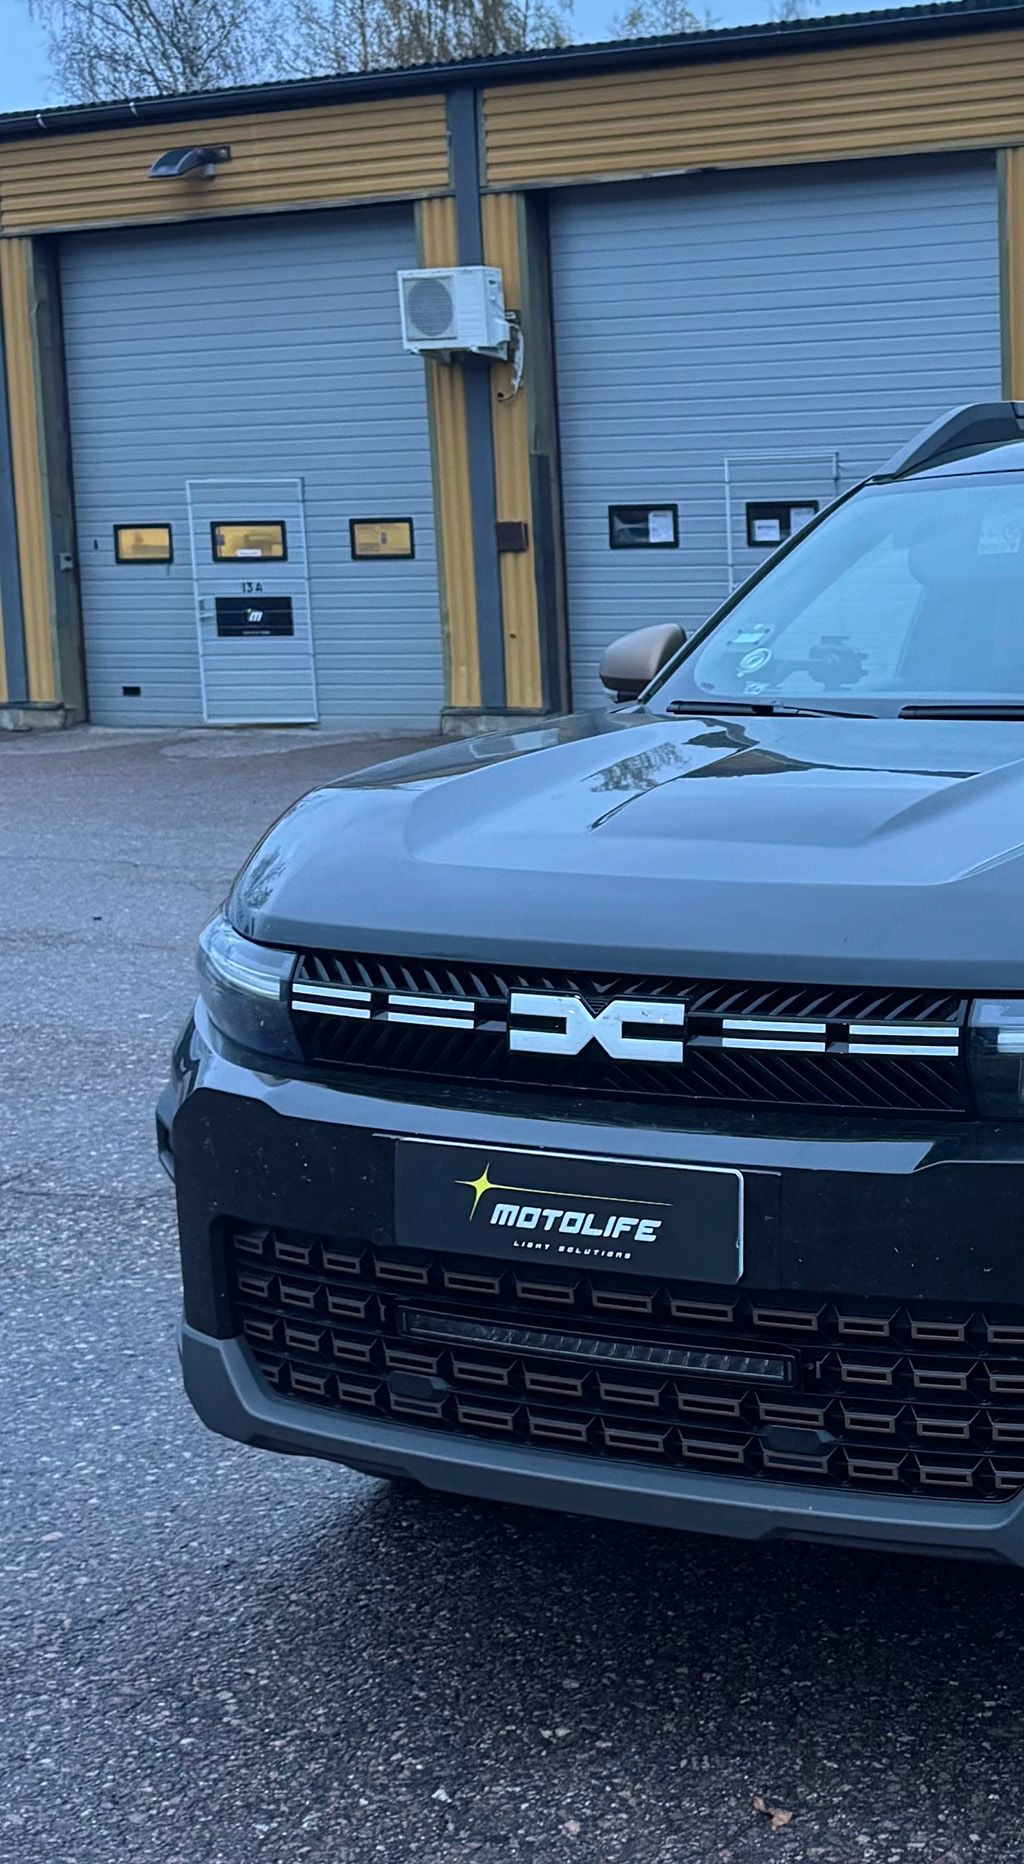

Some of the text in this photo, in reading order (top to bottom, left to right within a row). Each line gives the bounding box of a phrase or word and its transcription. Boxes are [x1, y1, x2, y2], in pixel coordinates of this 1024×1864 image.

[490, 1203, 662, 1242] MOTOLIFE
[513, 1240, 631, 1259] LIGHT SOLUTIONS
